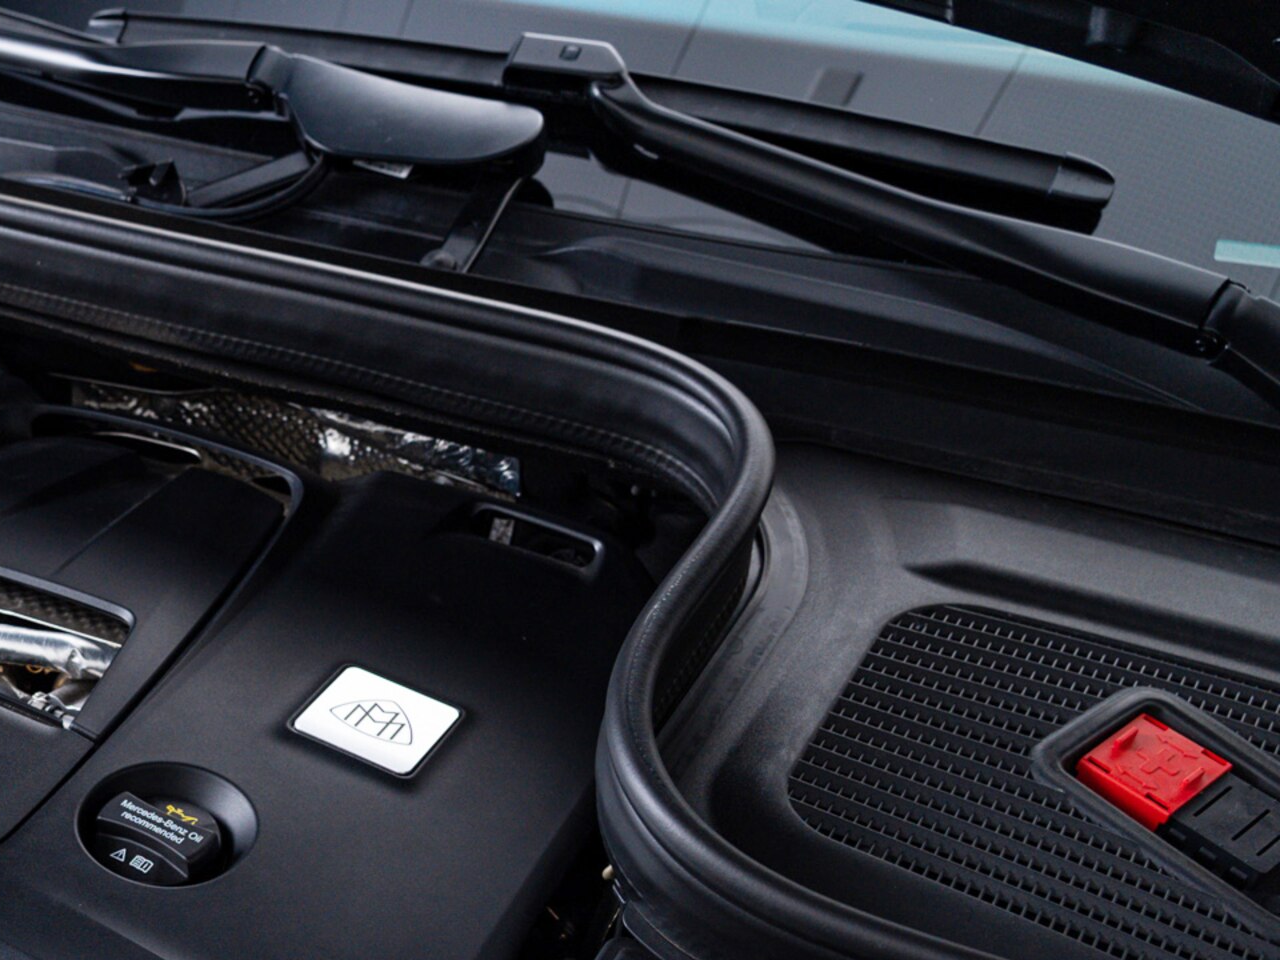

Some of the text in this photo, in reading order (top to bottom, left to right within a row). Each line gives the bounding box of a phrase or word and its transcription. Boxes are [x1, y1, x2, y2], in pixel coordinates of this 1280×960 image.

[120, 799, 204, 843] Mercedes-Benz Oil
[121, 811, 185, 845] recommended
